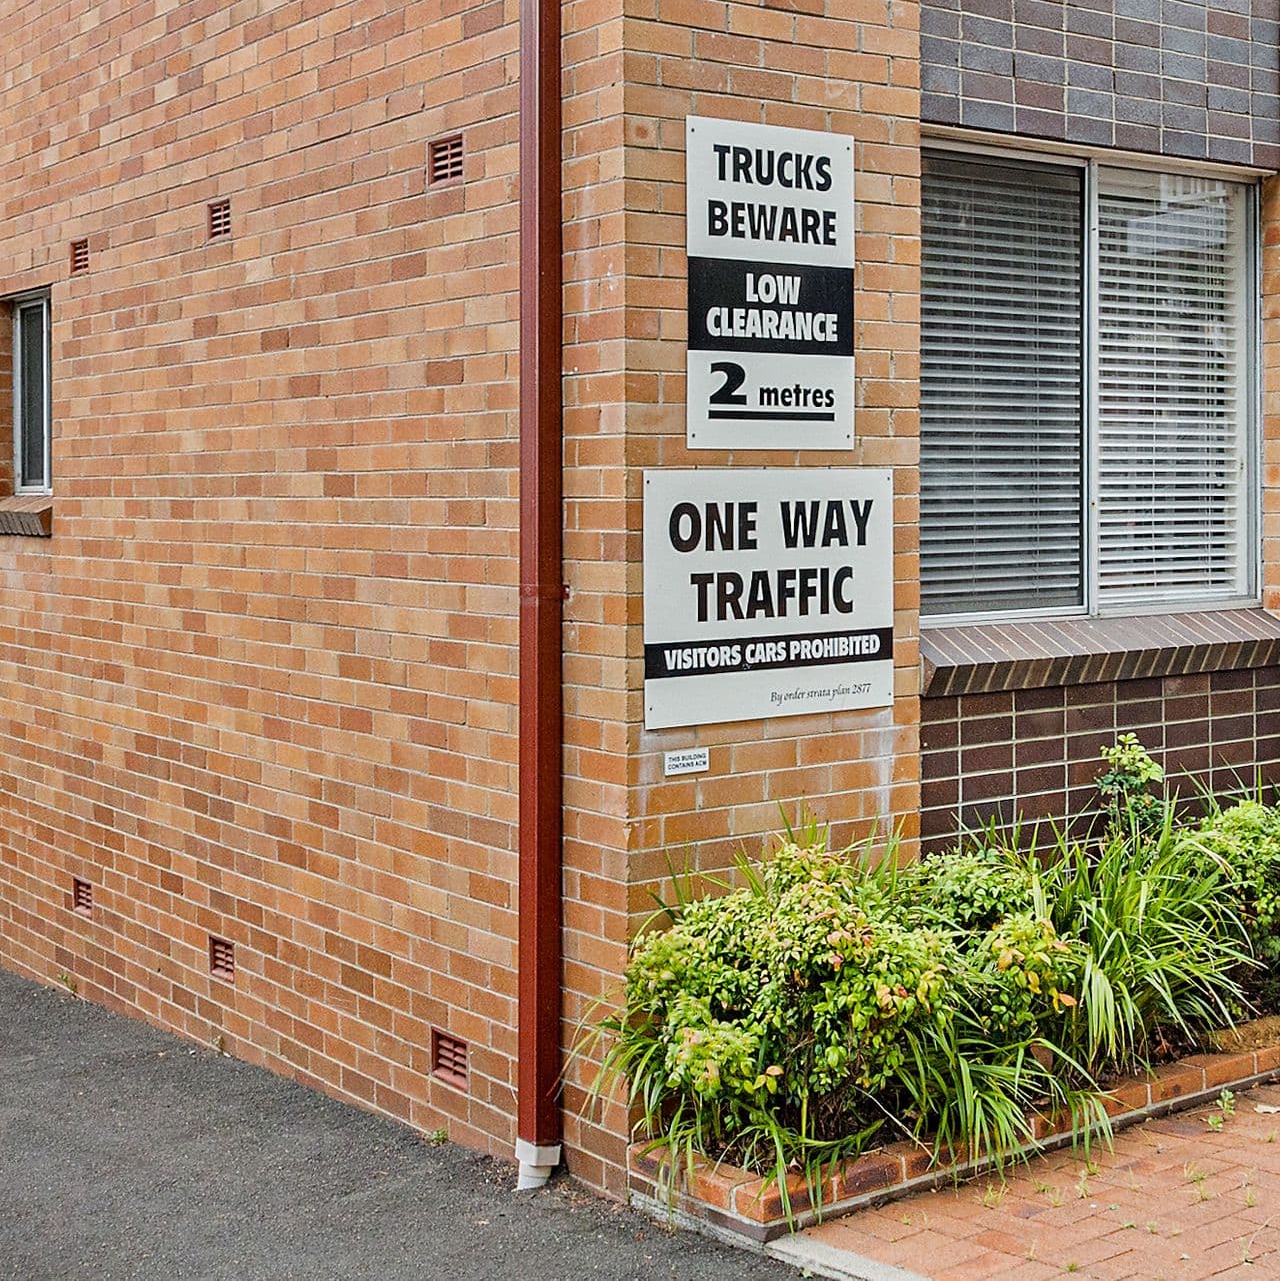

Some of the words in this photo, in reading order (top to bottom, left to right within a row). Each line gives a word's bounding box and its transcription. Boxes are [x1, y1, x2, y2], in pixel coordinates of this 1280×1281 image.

[713, 144, 832, 192] TRUCKS
[708, 199, 837, 246] BEWARE
[746, 272, 801, 305] LOW
[706, 306, 838, 342] CLEARANCE
[709, 362, 747, 406] 2
[759, 384, 835, 408] metres
[669, 501, 758, 553] ONE
[780, 499, 873, 548] WAY
[690, 566, 854, 622] TRAFFIC
[664, 645, 742, 670] VISITORS
[745, 640, 787, 664] CARS
[789, 634, 881, 661] PROHIBITED
[770, 691, 782, 706] By
[784, 687, 805, 701] order
[806, 689, 831, 699] strata
[829, 683, 850, 701] plan
[851, 683, 872, 695] 2877
